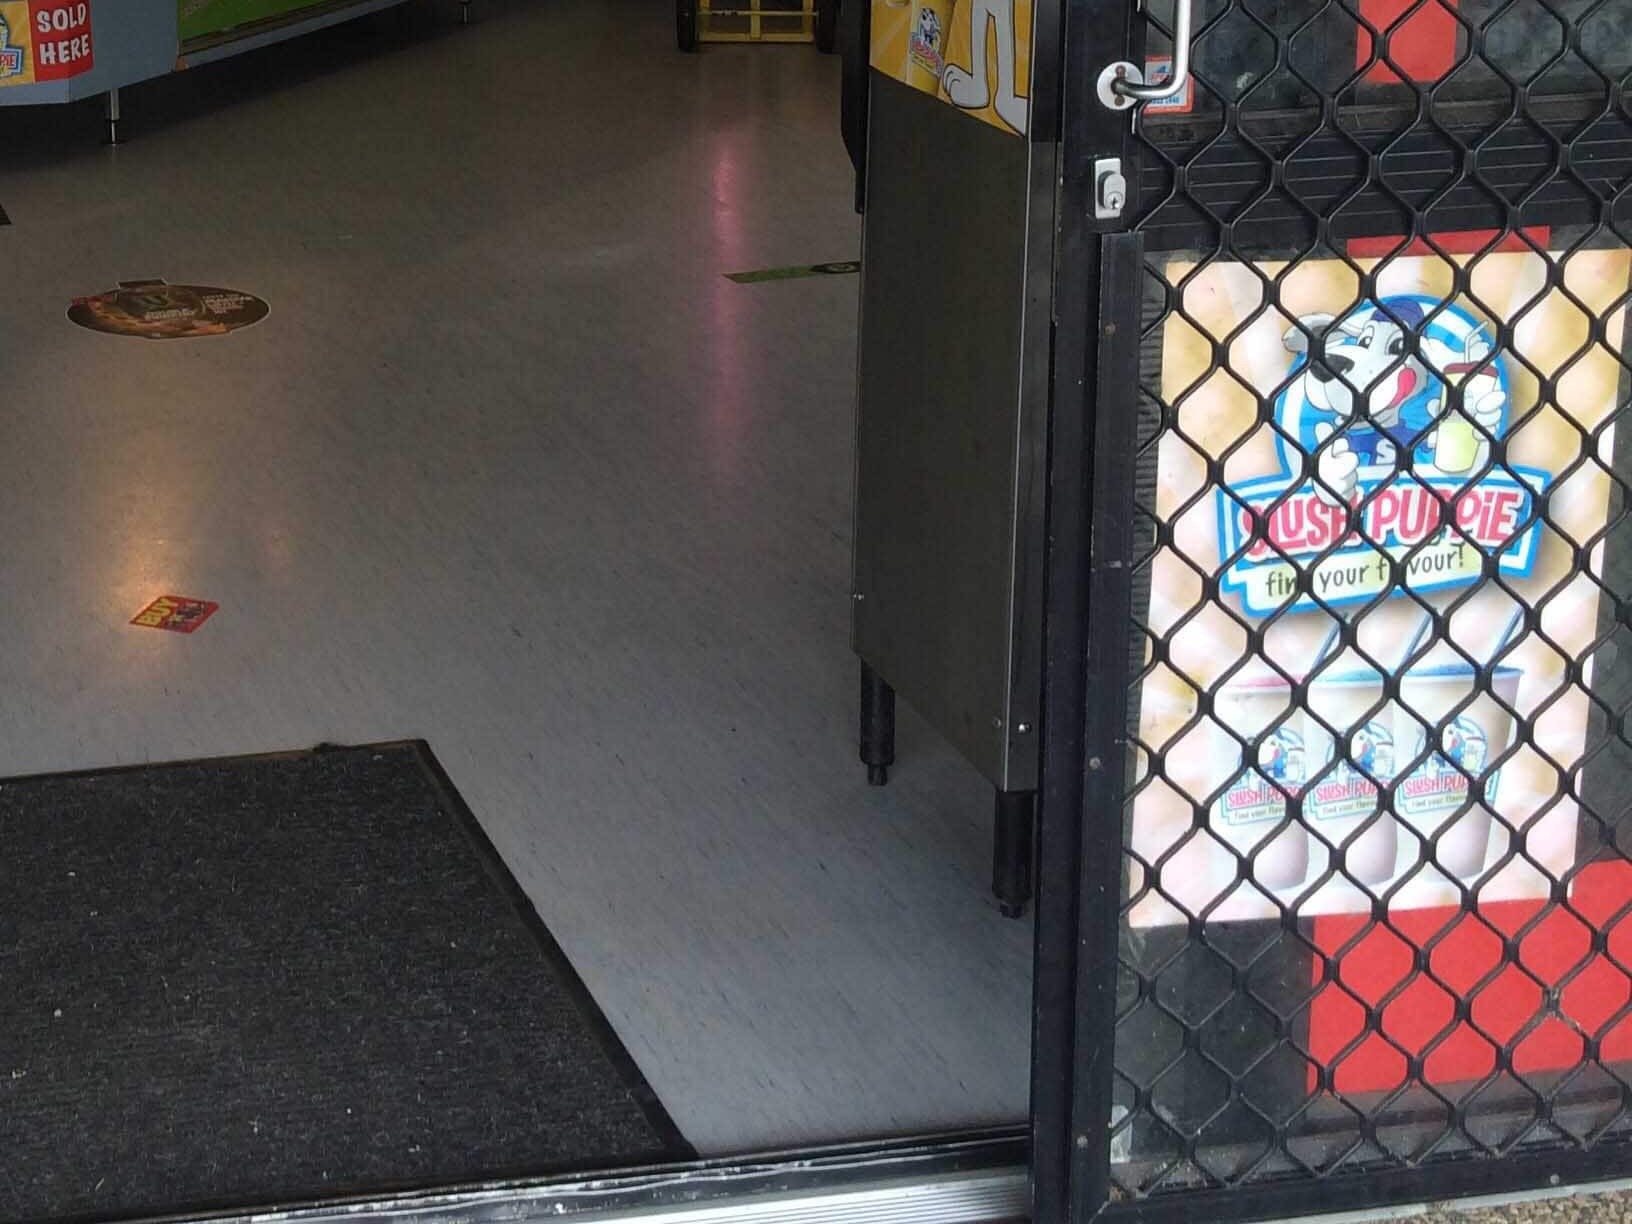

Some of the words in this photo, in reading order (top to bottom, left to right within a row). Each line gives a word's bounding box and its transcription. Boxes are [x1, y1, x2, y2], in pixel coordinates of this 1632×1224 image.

[36, 3, 87, 33] SOLD
[39, 33, 90, 66] HERE
[1266, 570, 1304, 598] fin
[1319, 564, 1371, 593] your
[1375, 543, 1466, 583] fvour!
